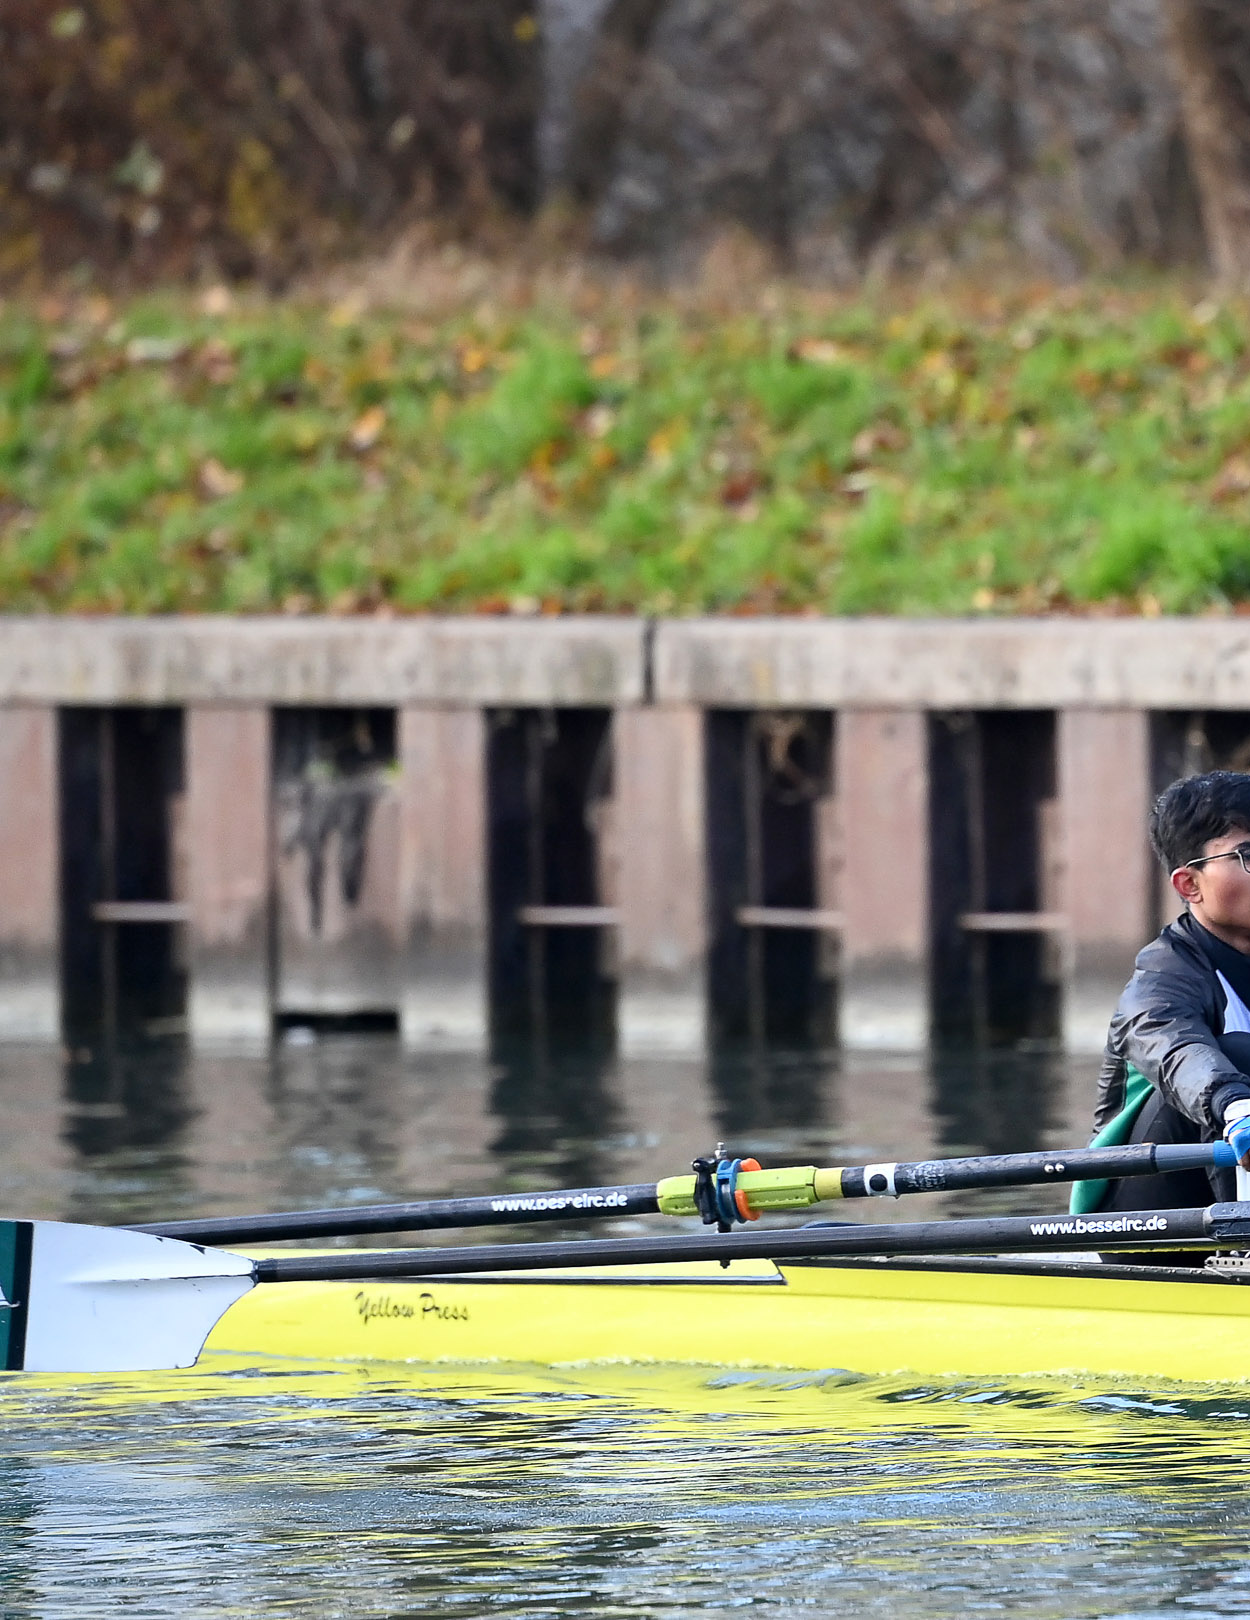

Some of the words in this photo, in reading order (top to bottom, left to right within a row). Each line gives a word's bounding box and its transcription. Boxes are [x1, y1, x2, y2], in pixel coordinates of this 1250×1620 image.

[1030, 1215, 1167, 1235] www.besselrc.de
[355, 1291, 414, 1325] Yellow
[420, 1292, 468, 1320] Press
